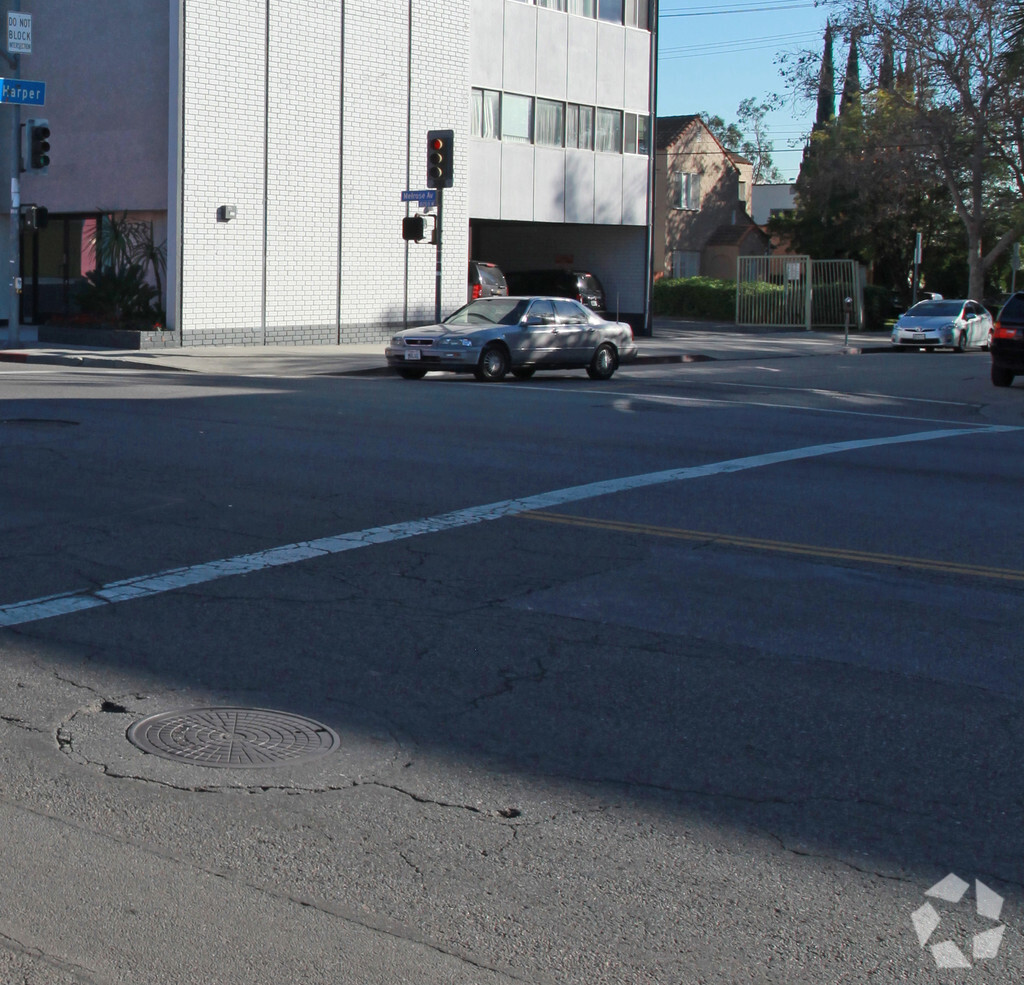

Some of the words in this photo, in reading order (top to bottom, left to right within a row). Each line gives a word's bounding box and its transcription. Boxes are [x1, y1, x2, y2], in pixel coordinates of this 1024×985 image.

[9, 17, 17, 27] DO
[20, 18, 31, 28] NOT
[9, 30, 31, 41] BLOCK
[2, 85, 40, 100] Harper
[403, 192, 425, 200] Melrose
